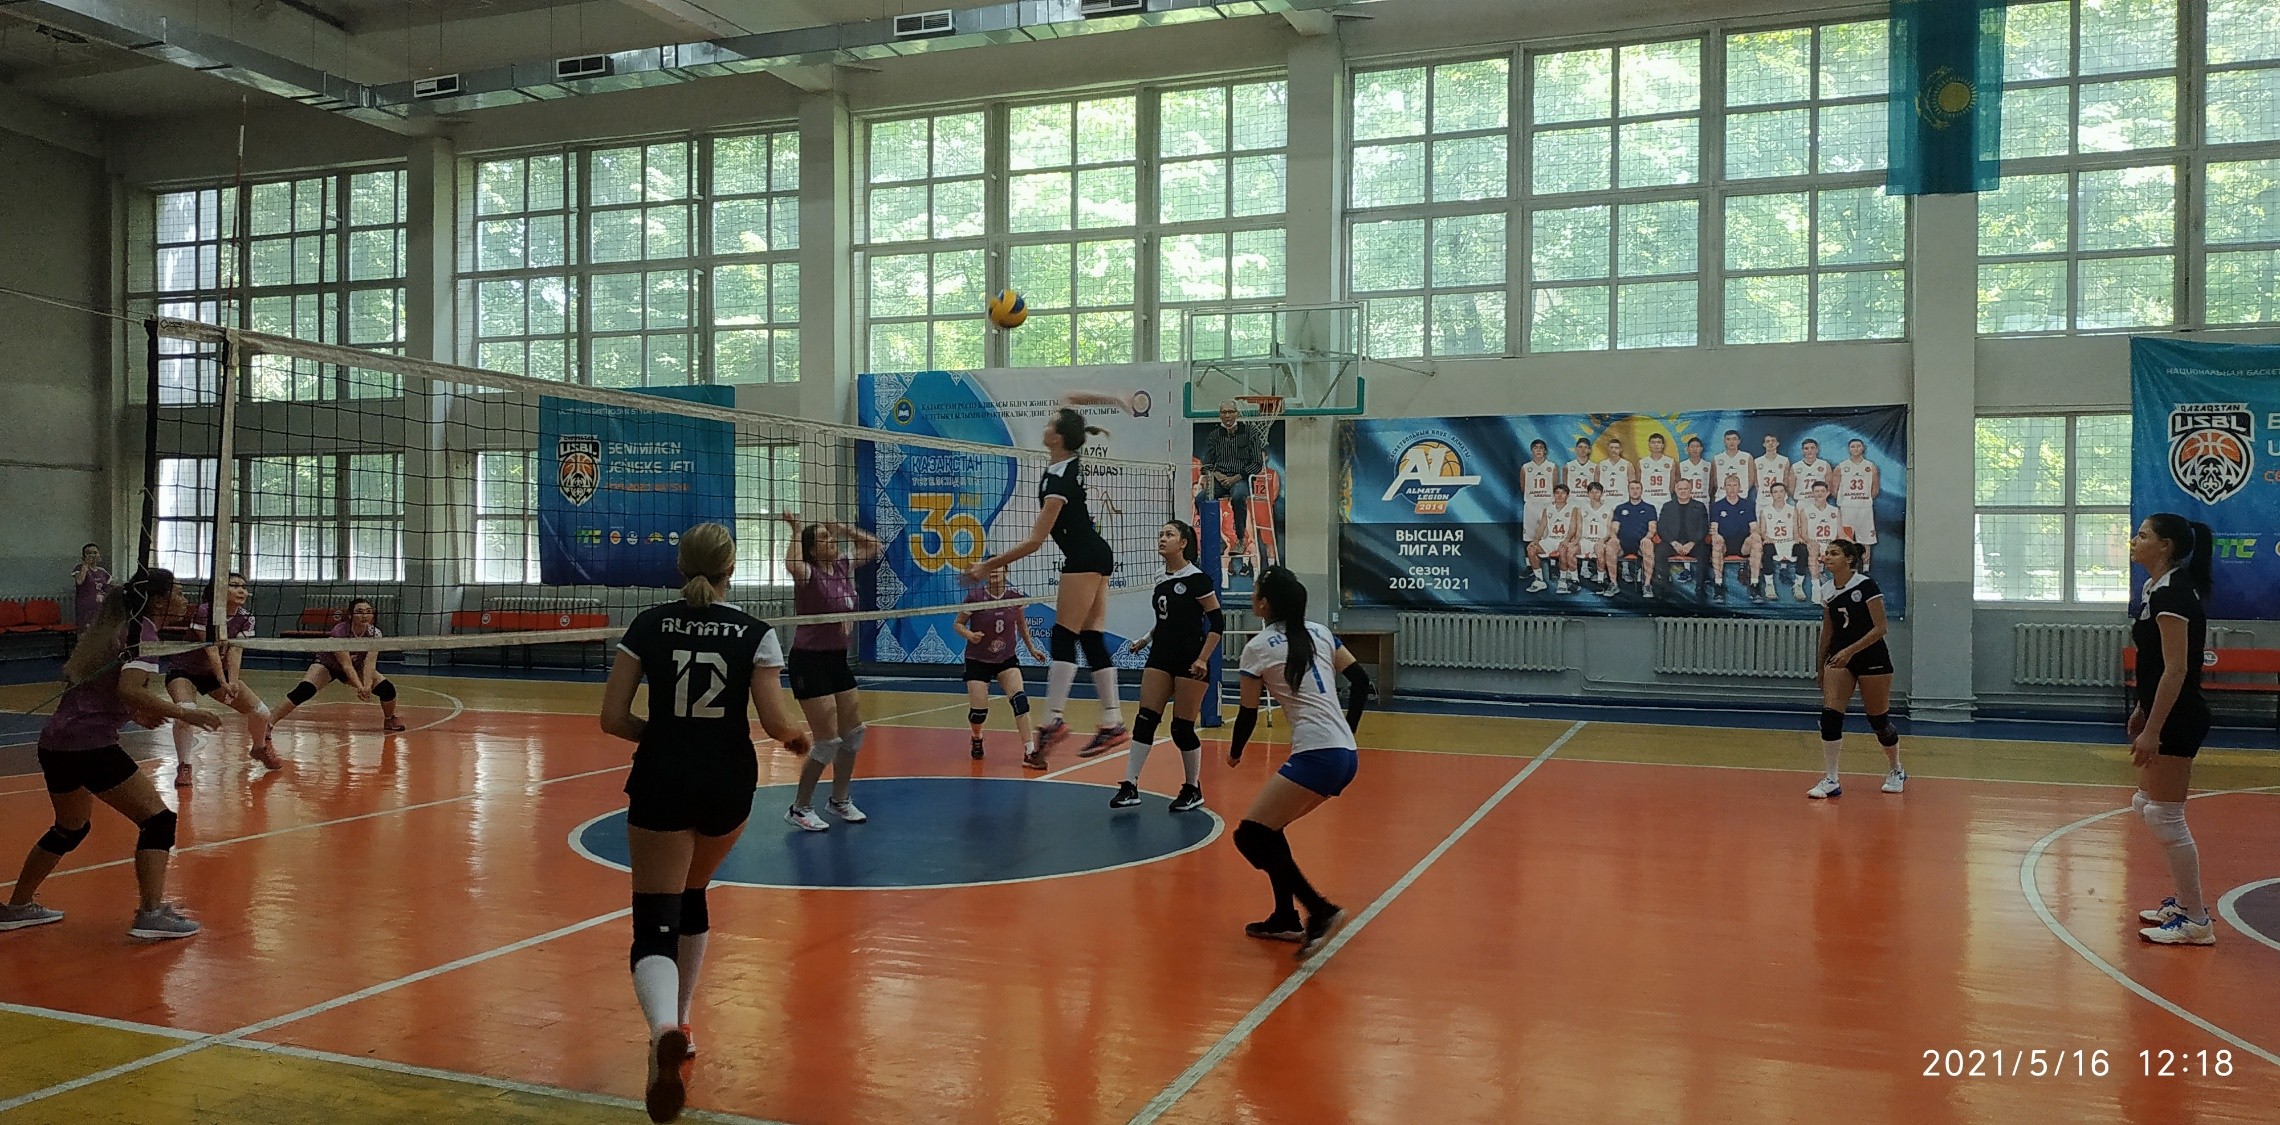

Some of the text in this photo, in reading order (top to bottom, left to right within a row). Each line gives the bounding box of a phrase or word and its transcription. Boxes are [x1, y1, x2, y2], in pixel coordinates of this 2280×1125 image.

[2180, 404, 2241, 413] QAZAQSTAN
[2174, 415, 2247, 433] USBL
[1533, 477, 1546, 489] 10
[1850, 479, 1864, 491] 33
[1405, 487, 1442, 495] ALMATY
[1418, 503, 1443, 511] 2014
[908, 492, 986, 574] 30
[1395, 529, 1464, 542] ВЫСШАЯ
[1773, 525, 1788, 537] 25
[1816, 525, 1831, 537] 26
[1398, 543, 1462, 557] ЛИГА РК
[1408, 565, 1450, 576] сезон
[1389, 577, 1469, 590] 2020-2021
[1157, 595, 1169, 620] 9
[661, 617, 749, 638] ALMATY
[995, 619, 1005, 634] 8
[672, 649, 728, 718] 12
